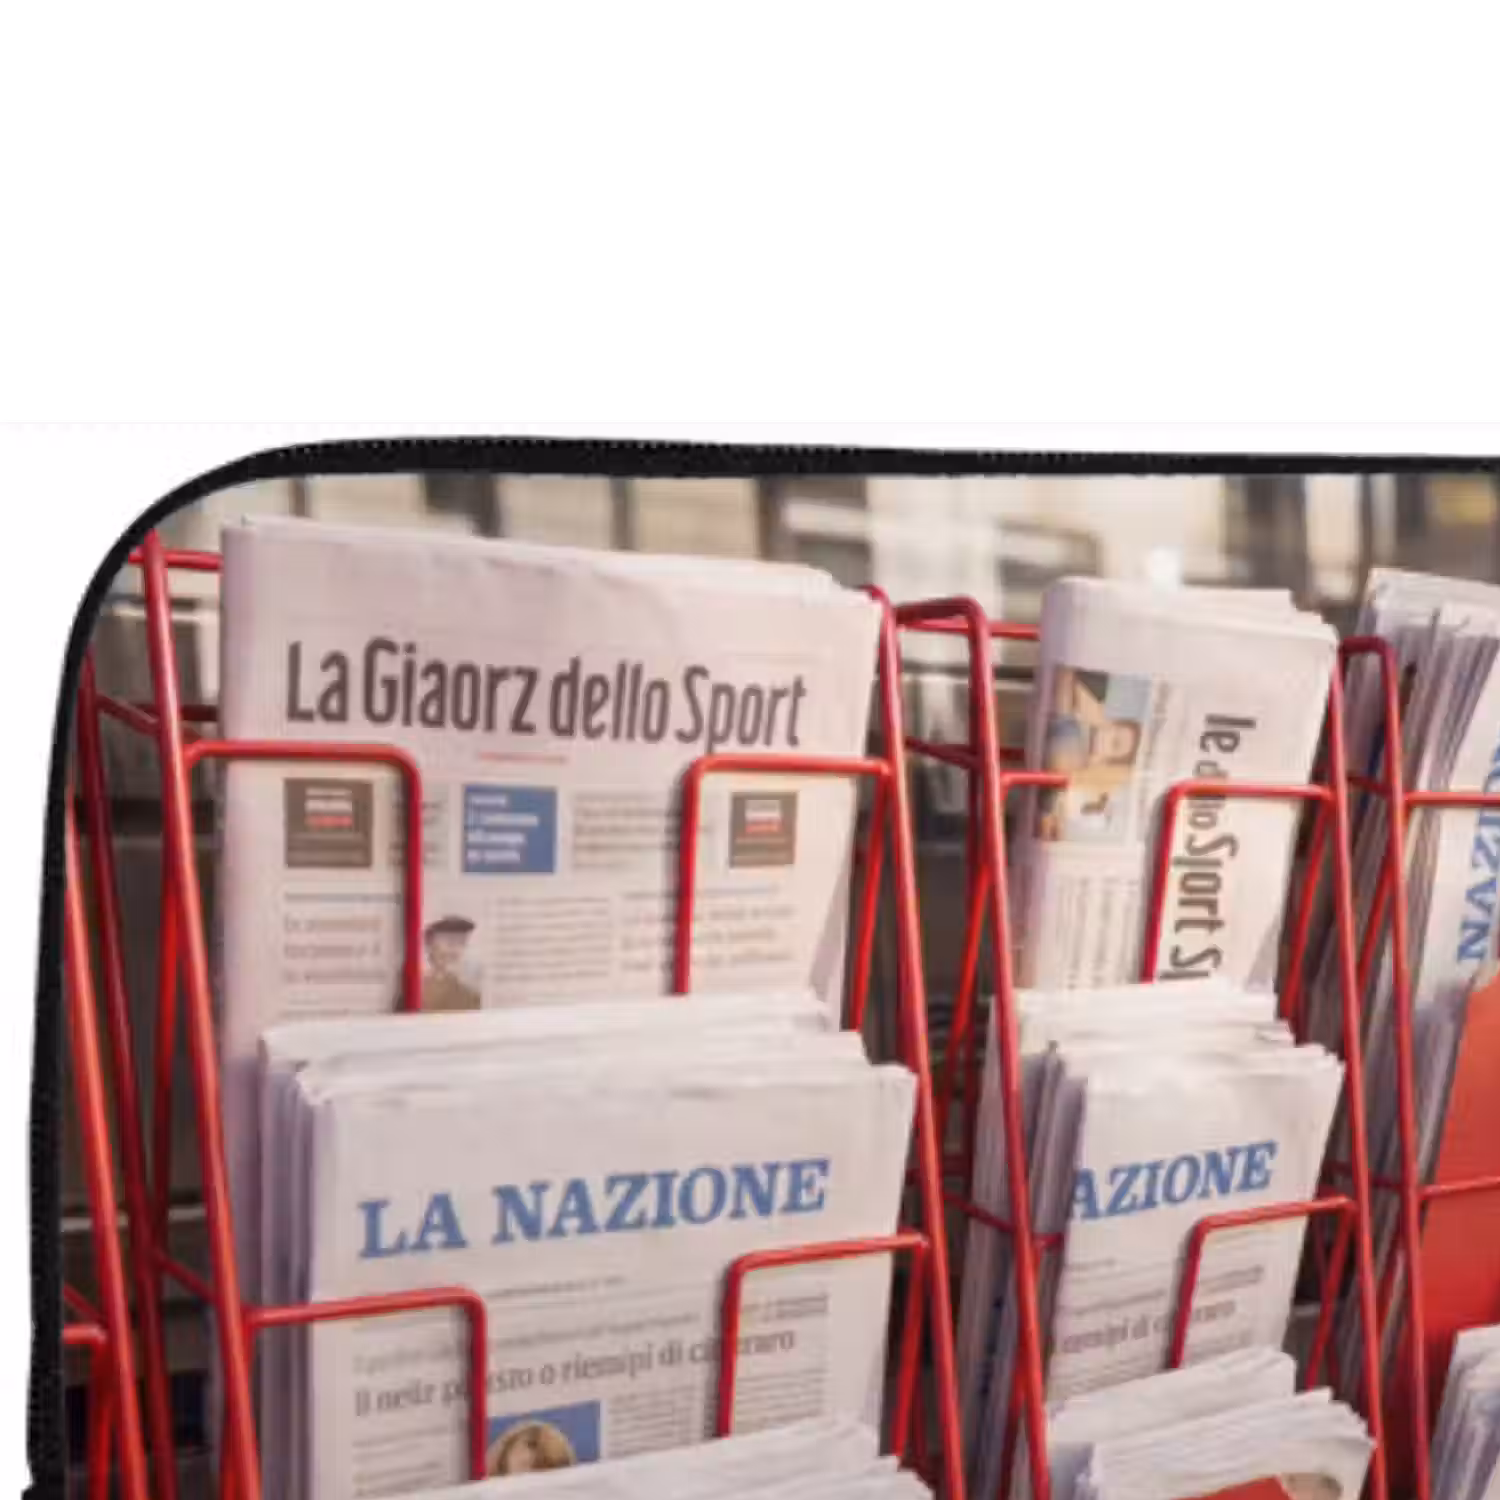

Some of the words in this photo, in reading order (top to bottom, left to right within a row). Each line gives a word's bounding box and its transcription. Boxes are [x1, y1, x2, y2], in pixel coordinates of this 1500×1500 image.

[286, 640, 350, 724] La
[363, 637, 538, 735] Giaorz
[549, 656, 671, 744] dello
[675, 665, 807, 755] Sport
[358, 1193, 467, 1259] LA
[491, 1157, 832, 1246] NAZIONE
[1072, 1139, 1280, 1221] AZIONE
